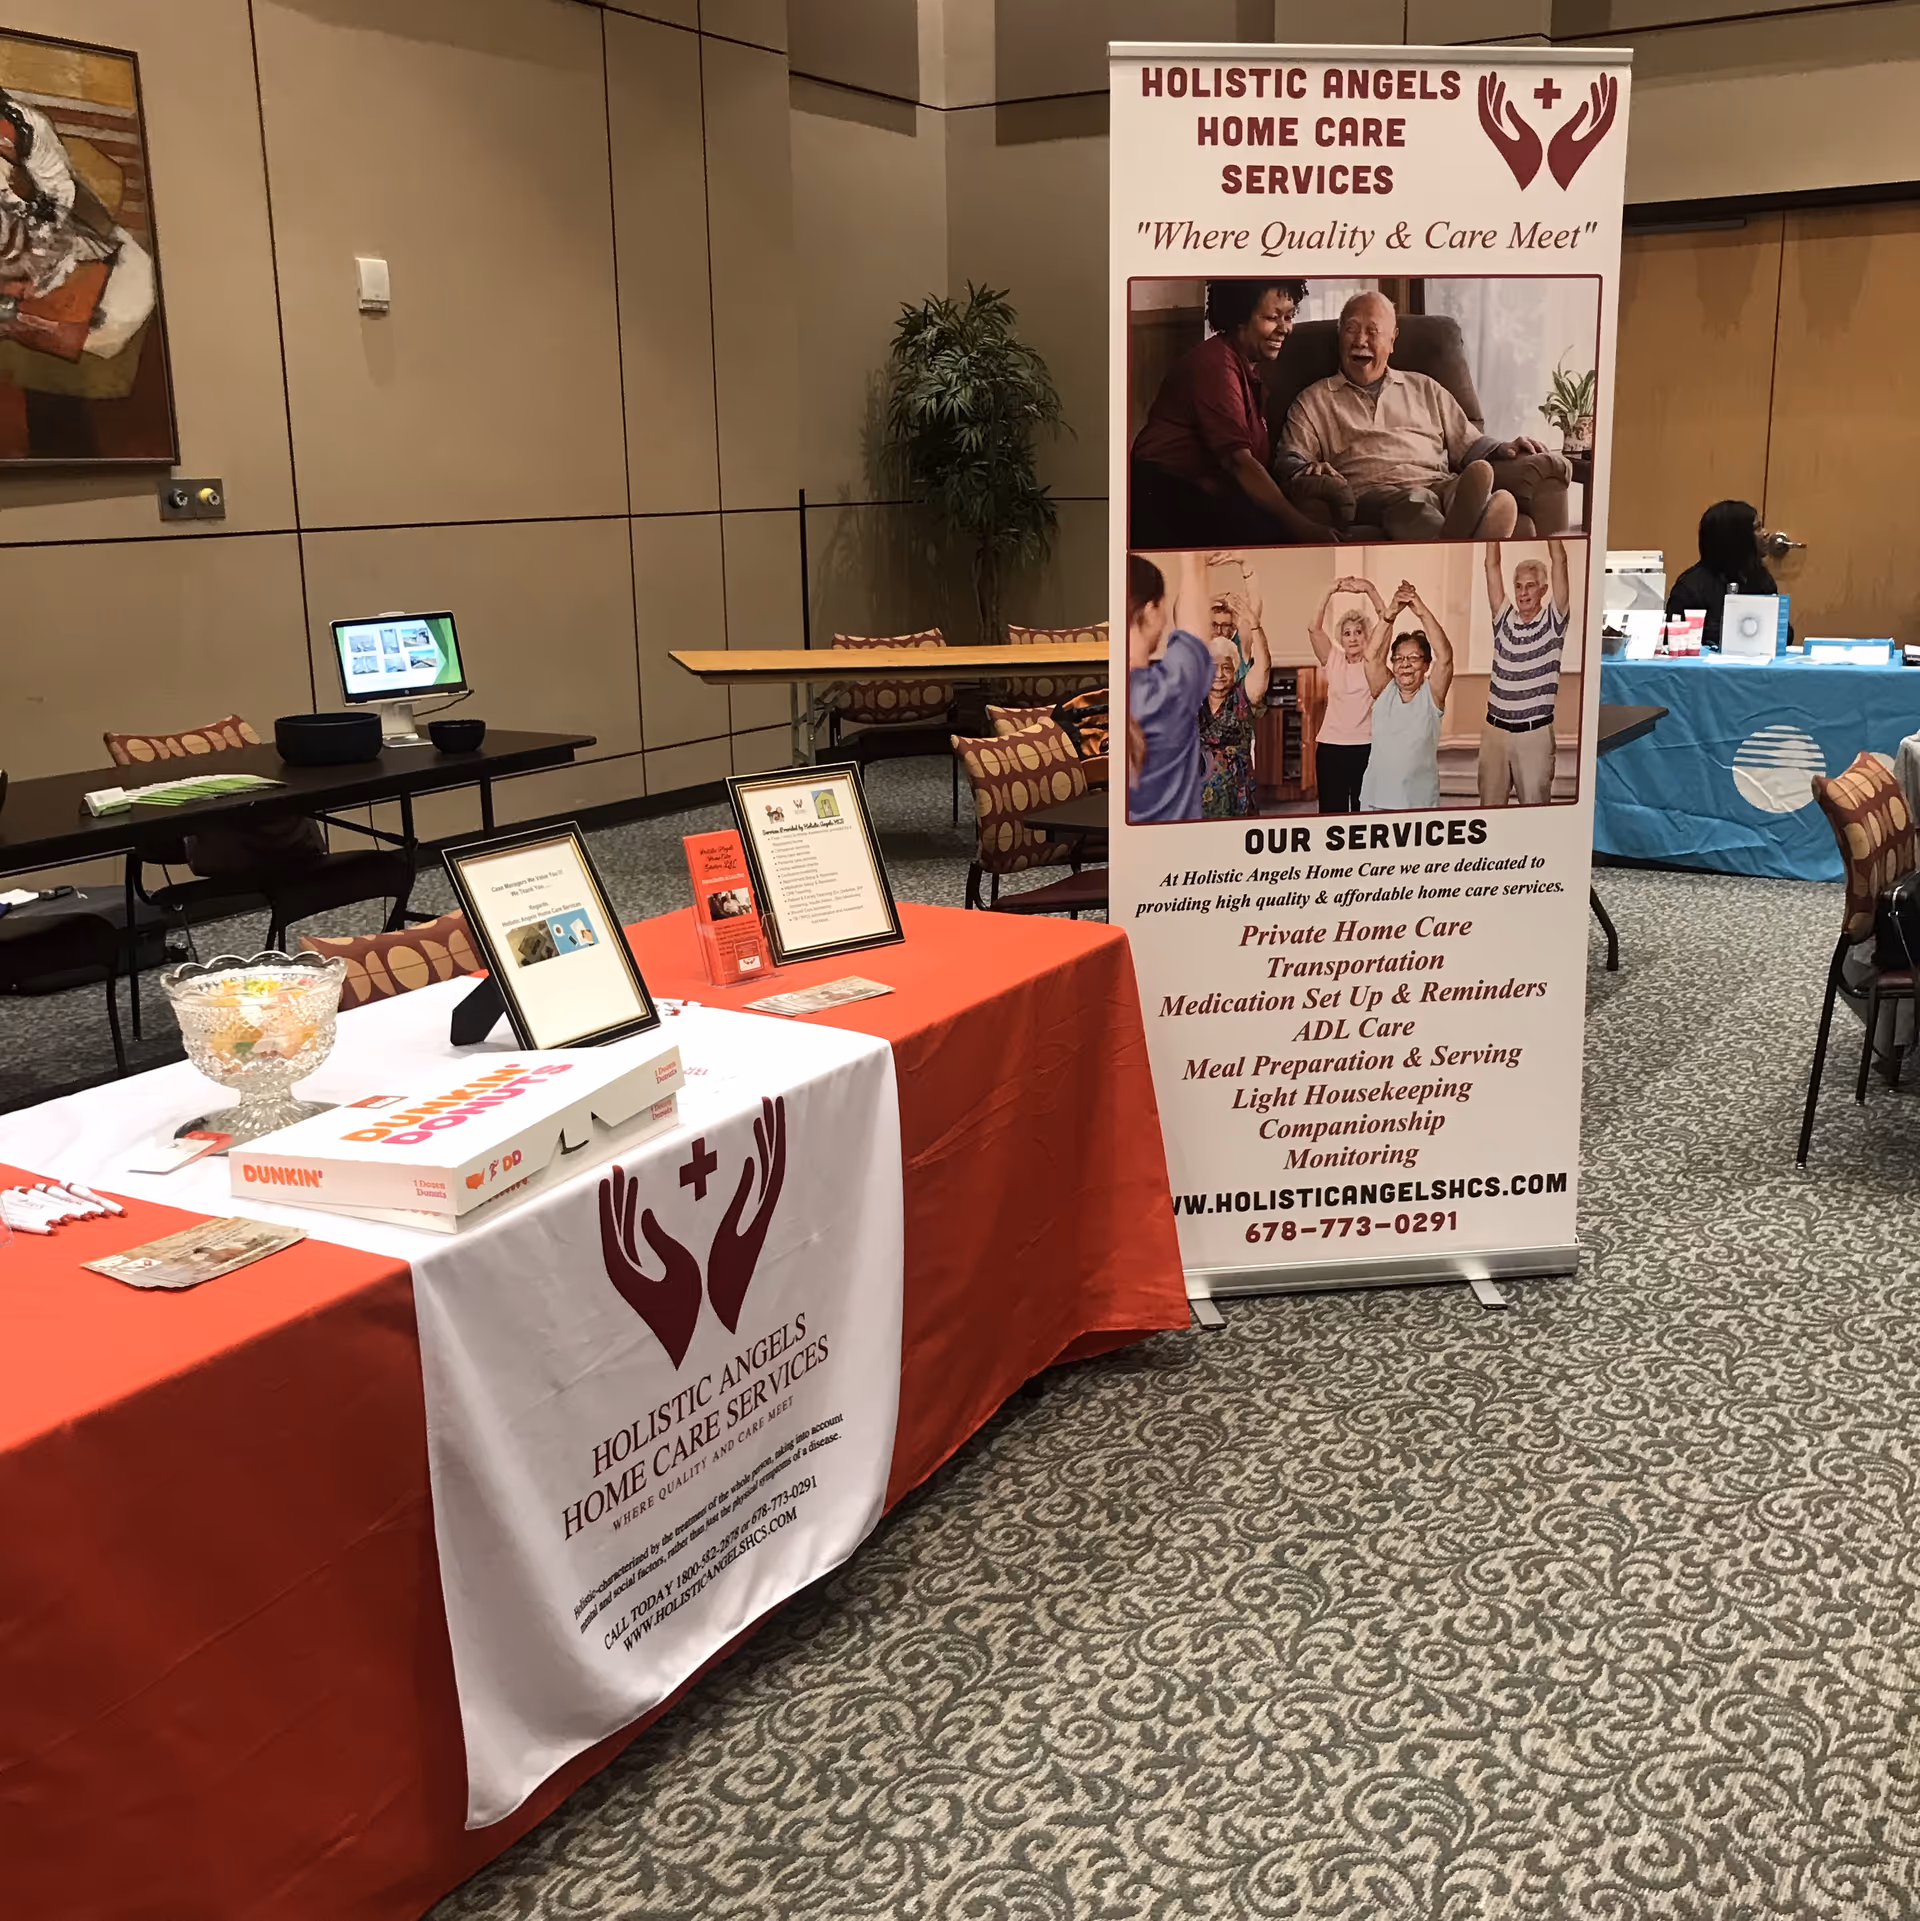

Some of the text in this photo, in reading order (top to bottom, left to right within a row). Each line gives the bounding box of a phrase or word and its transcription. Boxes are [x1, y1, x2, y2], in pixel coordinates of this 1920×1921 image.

[1142, 67, 1460, 100] HOLISTIC ANGELS
[1198, 116, 1405, 147] HOME CARE
[1222, 165, 1393, 194] SERVICES
[1138, 221, 1597, 257] "Where Quality & Care Meet"
[1245, 819, 1487, 854] OUR SERVICES
[1160, 855, 1545, 887] At Holistic Angels Home Care we are dedicated to
[1135, 880, 1564, 918] providing high quality & affordable home care services.
[1239, 916, 1472, 946] Private Home Care
[1268, 951, 1444, 981] Transportation
[1158, 978, 1547, 1017] Medication Set Up & Reminders
[1292, 1017, 1415, 1041] ADL Care
[1182, 1044, 1522, 1080] Meal Preparation & Serving
[340, 1064, 530, 1142] DUNKIN'
[380, 1064, 574, 1144] DONUTS
[1232, 1079, 1473, 1113] Light Housekeeping
[1260, 1110, 1445, 1142] Companionship
[502, 1150, 522, 1172] DD
[1283, 1144, 1419, 1169] Monitoring
[242, 1164, 323, 1188] DUNKIN'
[1246, 1211, 1456, 1243] 678-773-0291
[593, 1311, 807, 1478] HOLISTIC ANGELS
[562, 1334, 829, 1541] HOME CARE SERVICES
[613, 1396, 794, 1531] WHERE QUALITY AND CARE MEET
[574, 1413, 844, 1620] Holistic-characterized by the treatment of the whole person, taking into account
[580, 1606, 598, 1634] mental
[599, 1594, 612, 1612] and
[613, 1574, 636, 1599] social
[637, 1554, 666, 1581] factors,
[668, 1538, 688, 1560] rather
[690, 1524, 704, 1541] than
[705, 1512, 719, 1531] just
[720, 1504, 731, 1518] the
[732, 1479, 758, 1512] physical
[759, 1457, 792, 1486] symptoms
[793, 1448, 802, 1461] of
[808, 1432, 842, 1452] disease.
[604, 1475, 818, 1650] CALL TODAY 1800-582-2878 or 678-773-0291
[623, 1506, 798, 1652] WWW.HOLISTICANGELSHCS.COM
